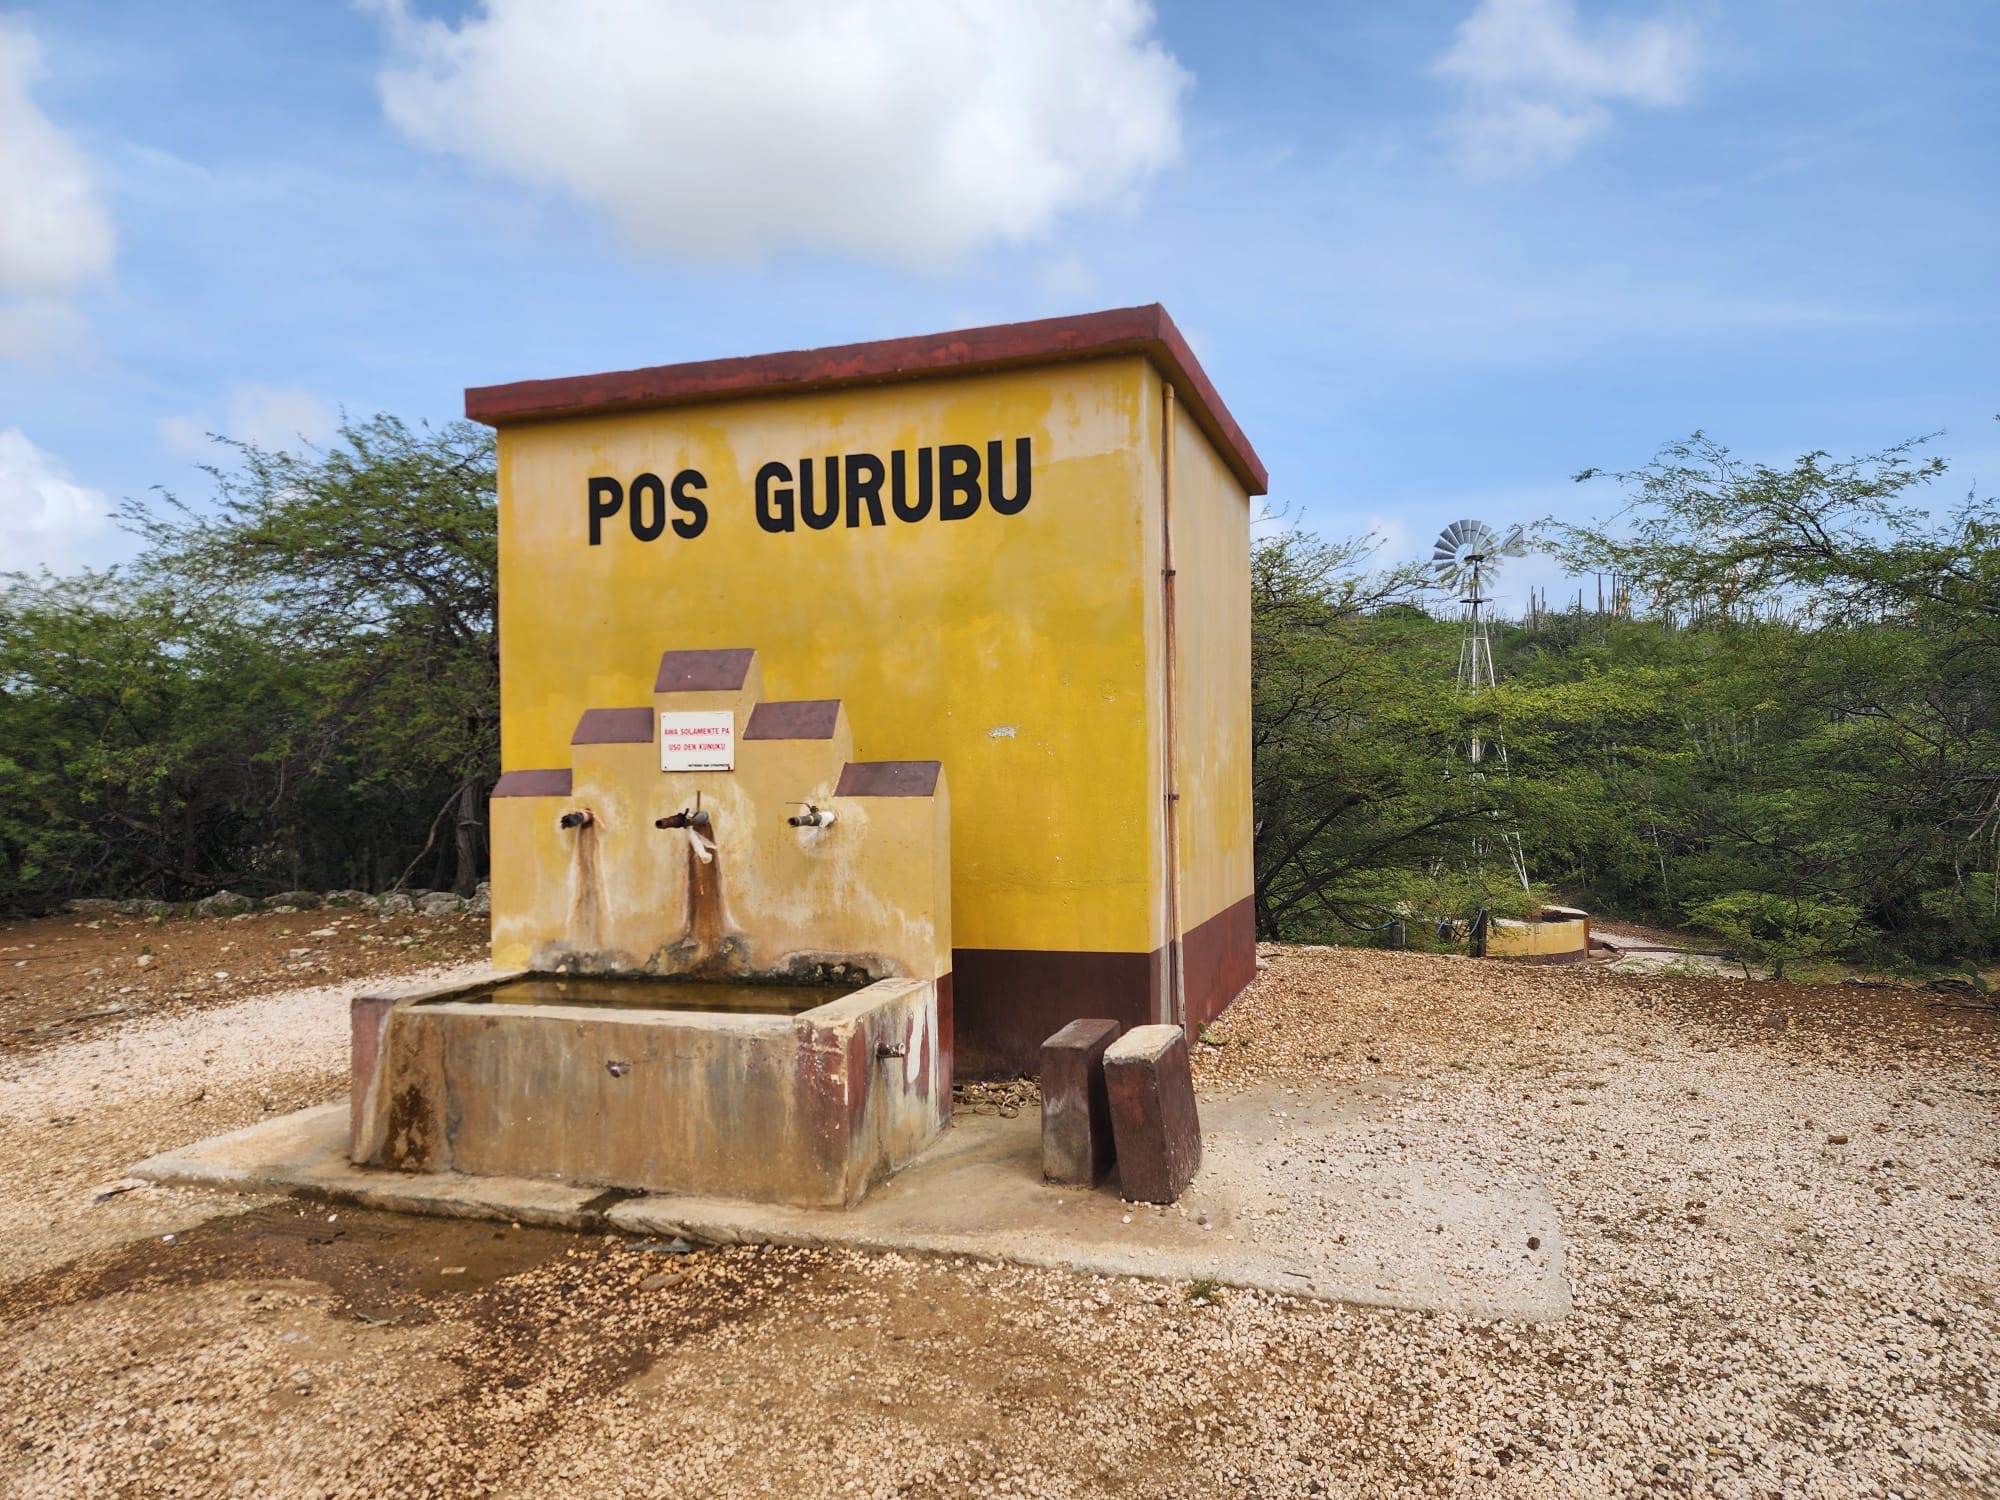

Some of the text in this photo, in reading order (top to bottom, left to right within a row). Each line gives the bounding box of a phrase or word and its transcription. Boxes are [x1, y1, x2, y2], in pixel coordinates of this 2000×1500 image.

[588, 437, 1031, 545] POS GURUBU
[681, 728, 719, 736] SOLAMENTE
[721, 727, 730, 735] PA
[699, 743, 726, 751] KUNUKU
